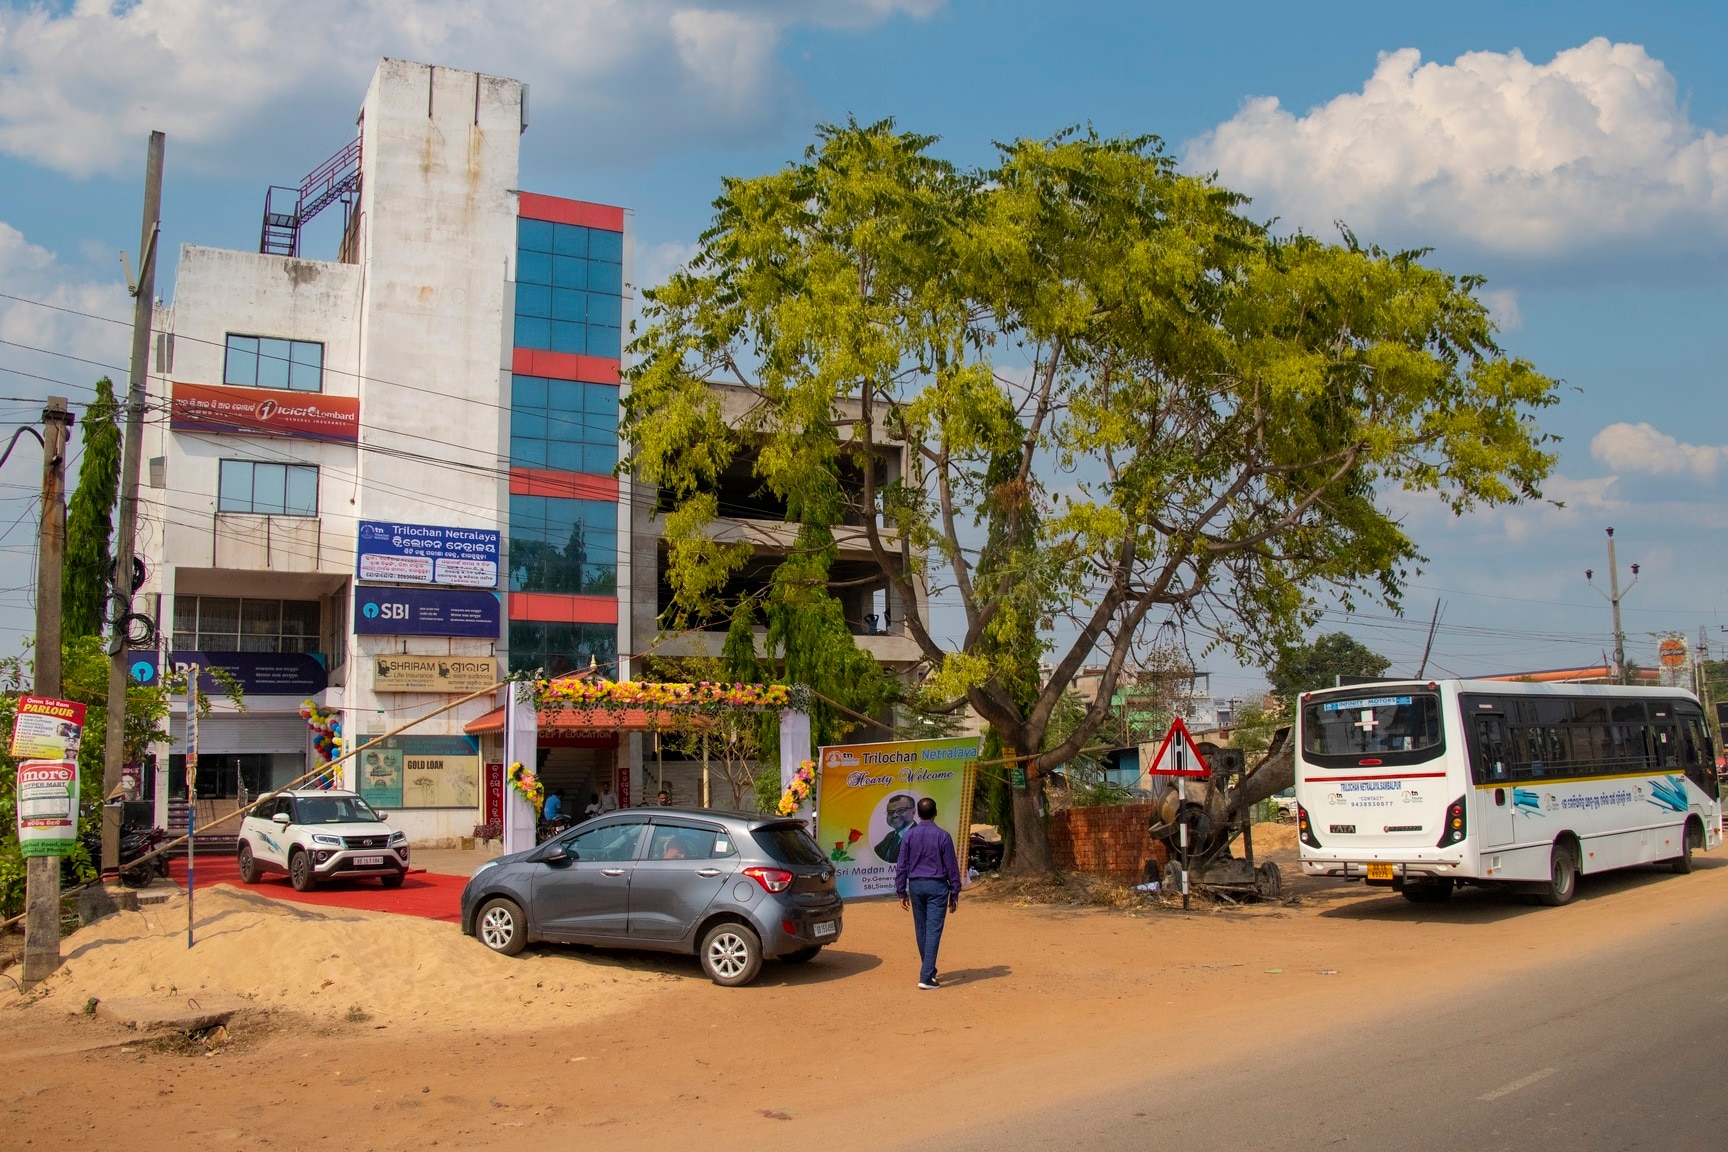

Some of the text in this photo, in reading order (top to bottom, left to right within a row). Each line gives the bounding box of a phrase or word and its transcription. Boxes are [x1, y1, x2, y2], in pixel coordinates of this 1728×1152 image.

[317, 409, 355, 420] Lombard
[392, 525, 497, 542] Trilochan Netralaya
[380, 603, 409, 619] SBI
[390, 661, 435, 671] SHRIRAM
[23, 703, 74, 717] PARLOUR
[863, 751, 917, 764] Trilochan
[922, 747, 978, 760] Netralaya
[407, 760, 444, 769] GOLD LOAN
[23, 770, 69, 781] more
[847, 767, 954, 788] Hearty Welcome
[1331, 825, 1355, 833] TATA
[836, 868, 849, 876] Sri
[852, 866, 885, 875] Madan
